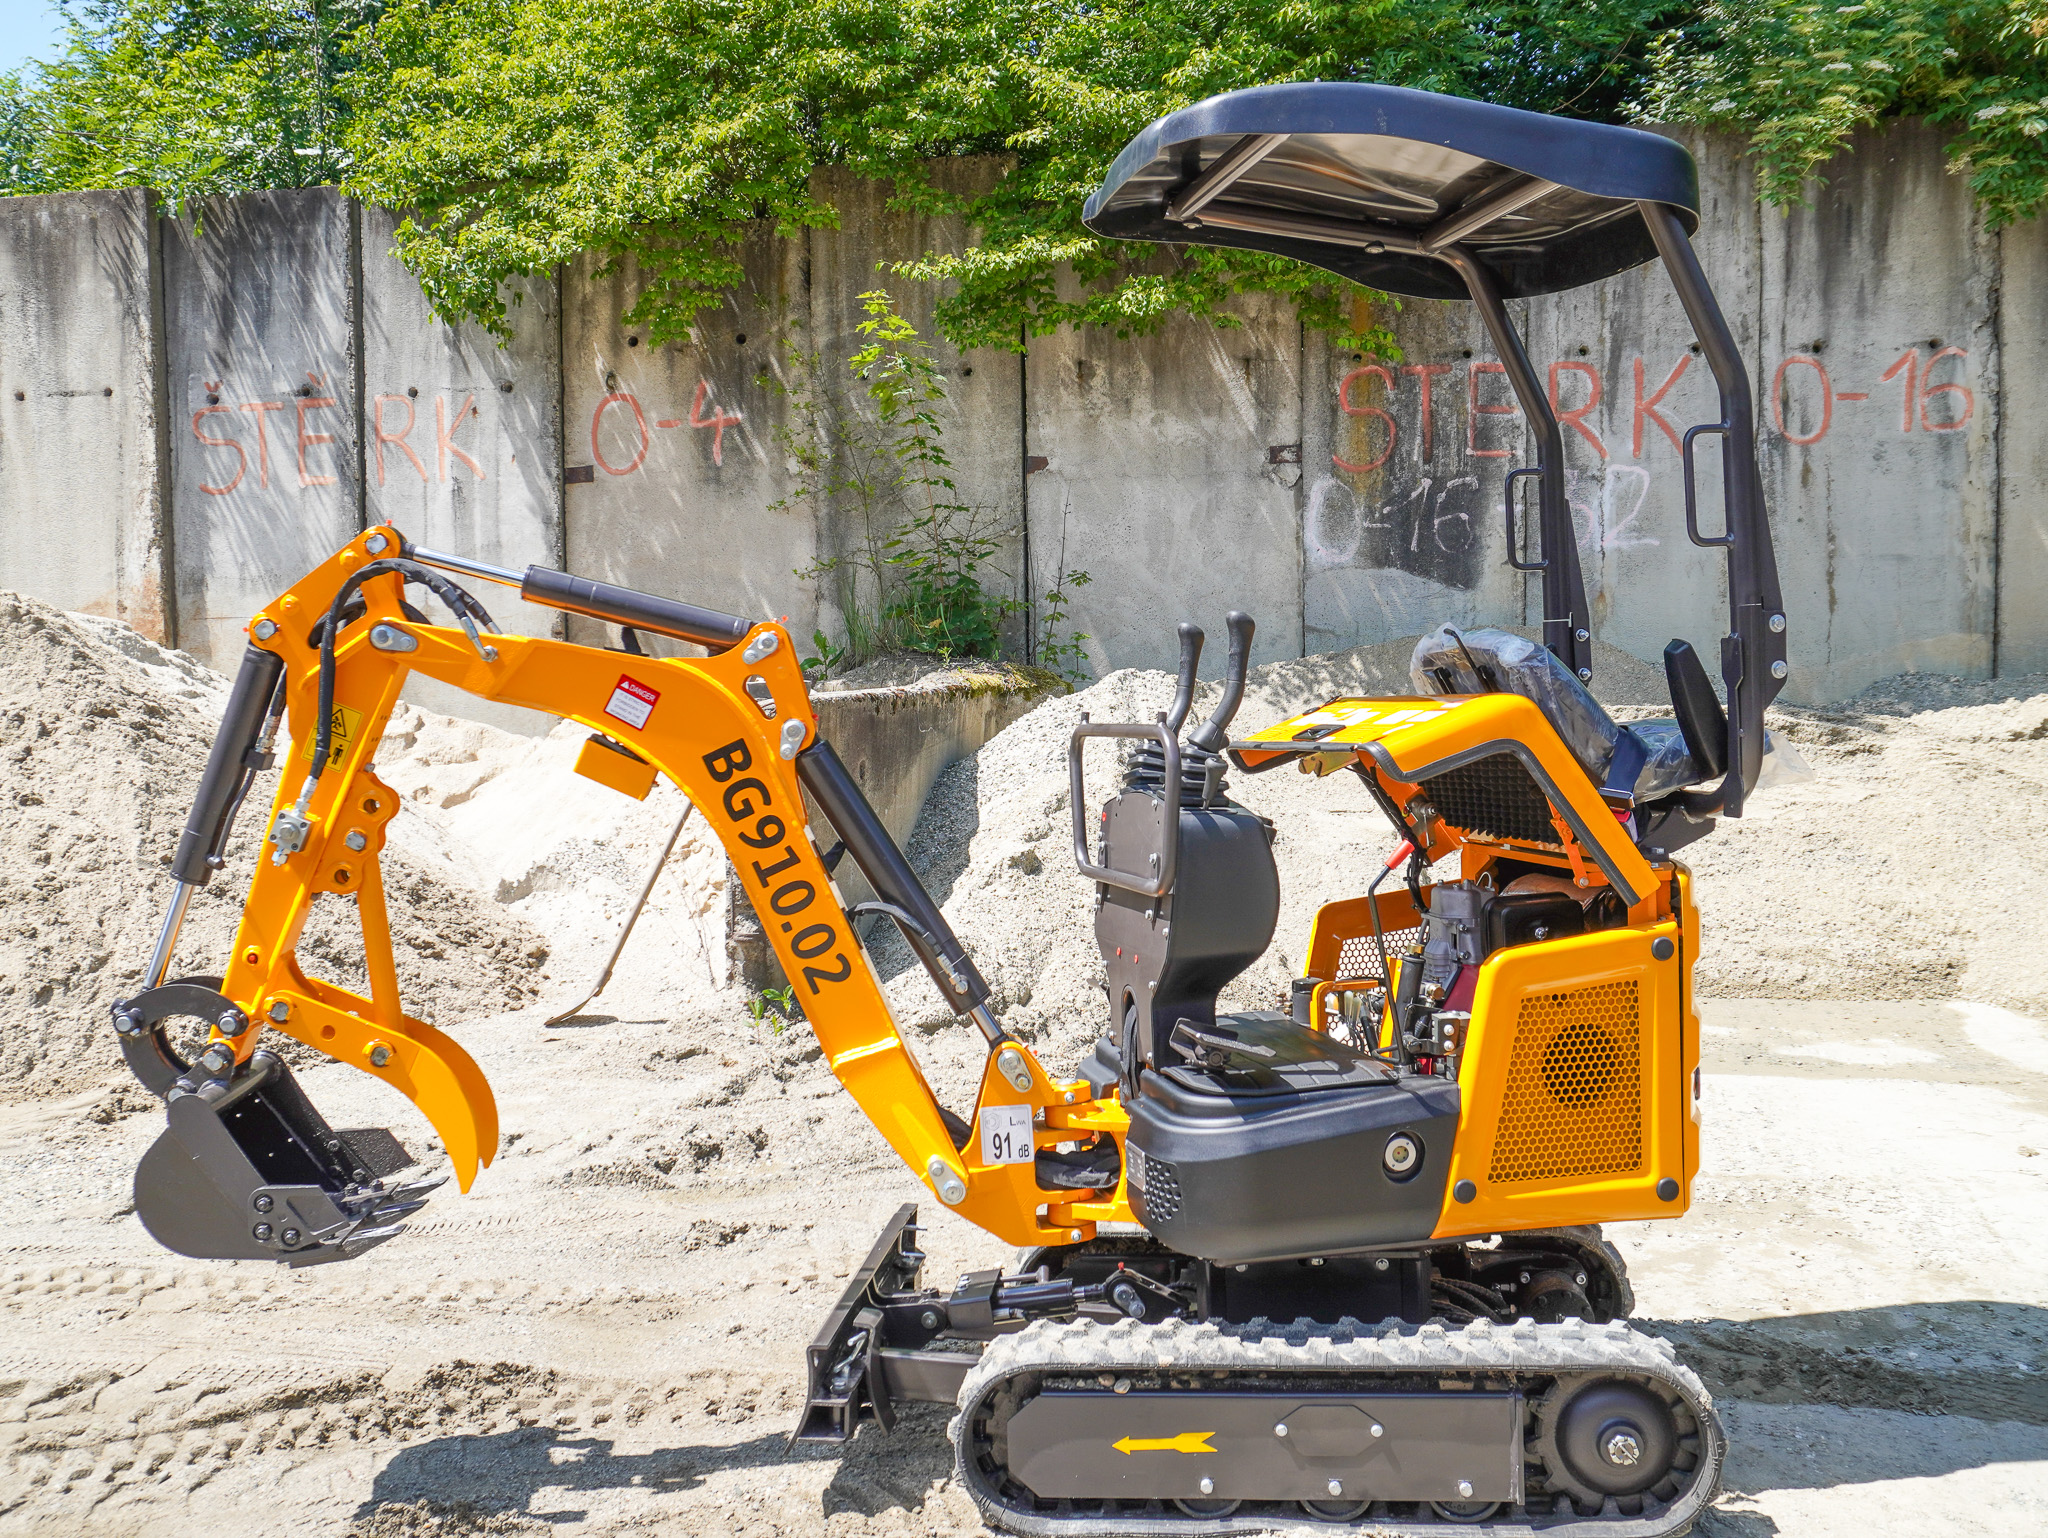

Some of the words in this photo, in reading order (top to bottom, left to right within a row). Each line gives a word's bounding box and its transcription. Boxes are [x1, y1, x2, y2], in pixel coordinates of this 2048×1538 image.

[591, 379, 742, 467] 0-4
[1772, 345, 1975, 446] 0-16
[629, 684, 655, 702] DANGER
[702, 738, 852, 995] BG910.02
[992, 1131, 1012, 1160] 91
[1018, 1143, 1030, 1158] dB
